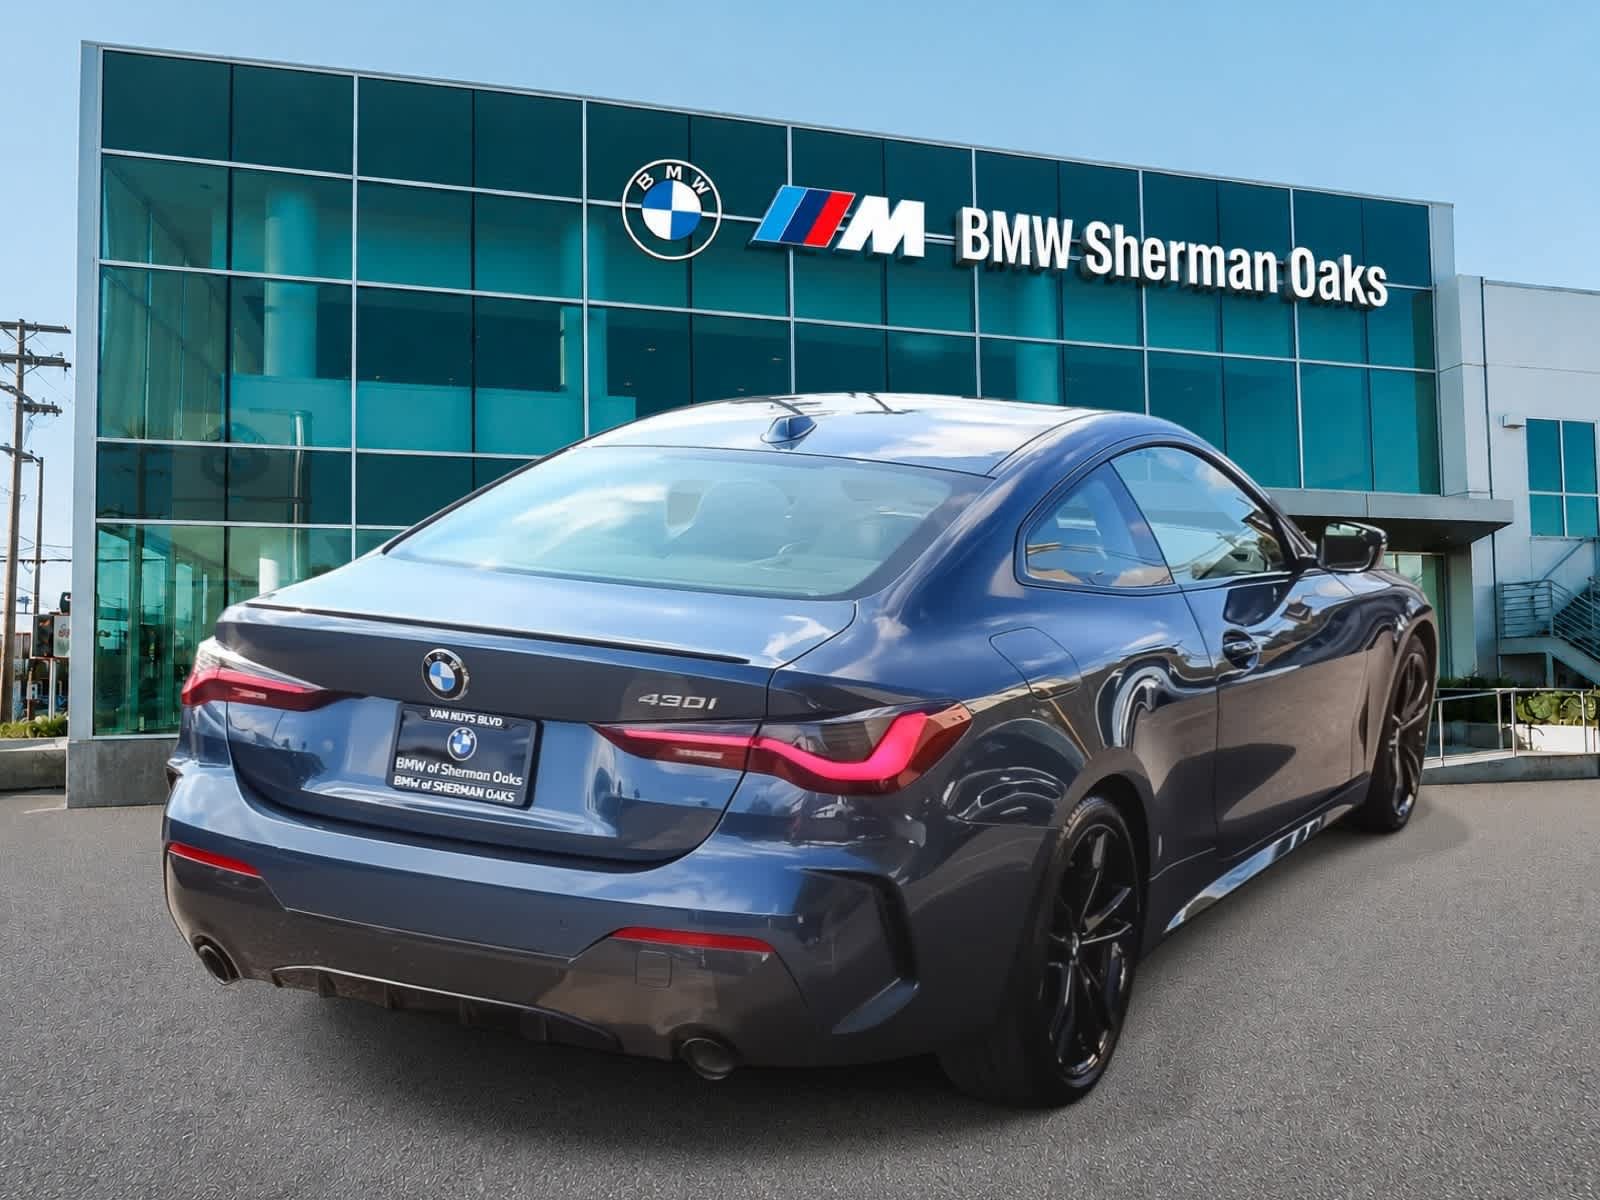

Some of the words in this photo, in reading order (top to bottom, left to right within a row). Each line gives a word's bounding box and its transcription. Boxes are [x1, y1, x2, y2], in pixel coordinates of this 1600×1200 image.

[637, 165, 711, 194] BMW
[961, 206, 1073, 270] BMW
[1085, 220, 1278, 293] Sherman
[1290, 246, 1388, 307] Oaks
[430, 709, 449, 720] VAN
[450, 711, 476, 723] NUYS
[477, 715, 503, 727] BLVD
[396, 757, 425, 772] BMW
[427, 762, 440, 774] of
[441, 763, 490, 781] Sherman
[493, 771, 523, 786] Oaks
[393, 775, 421, 788] BMW
[421, 780, 432, 789] of
[433, 781, 484, 798] SHERMAN
[485, 790, 516, 802] OAKS
